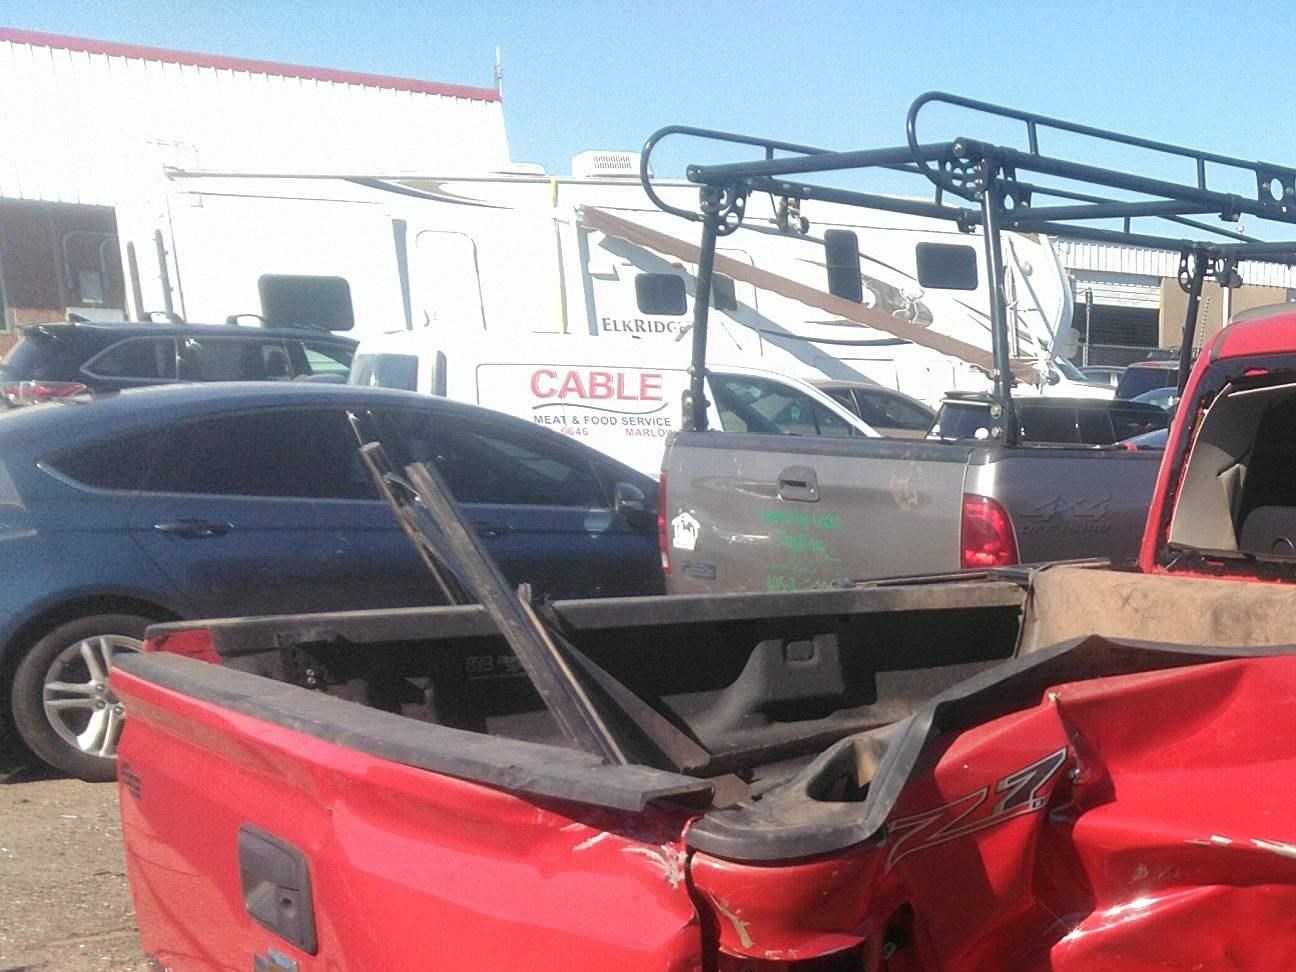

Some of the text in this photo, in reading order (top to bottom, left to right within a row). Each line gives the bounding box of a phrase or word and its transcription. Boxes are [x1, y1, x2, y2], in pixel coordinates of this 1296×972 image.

[601, 317, 688, 334] ELKRIDG
[530, 368, 663, 401] CABLE
[533, 415, 672, 427] MEAT & FOOD SERVICE
